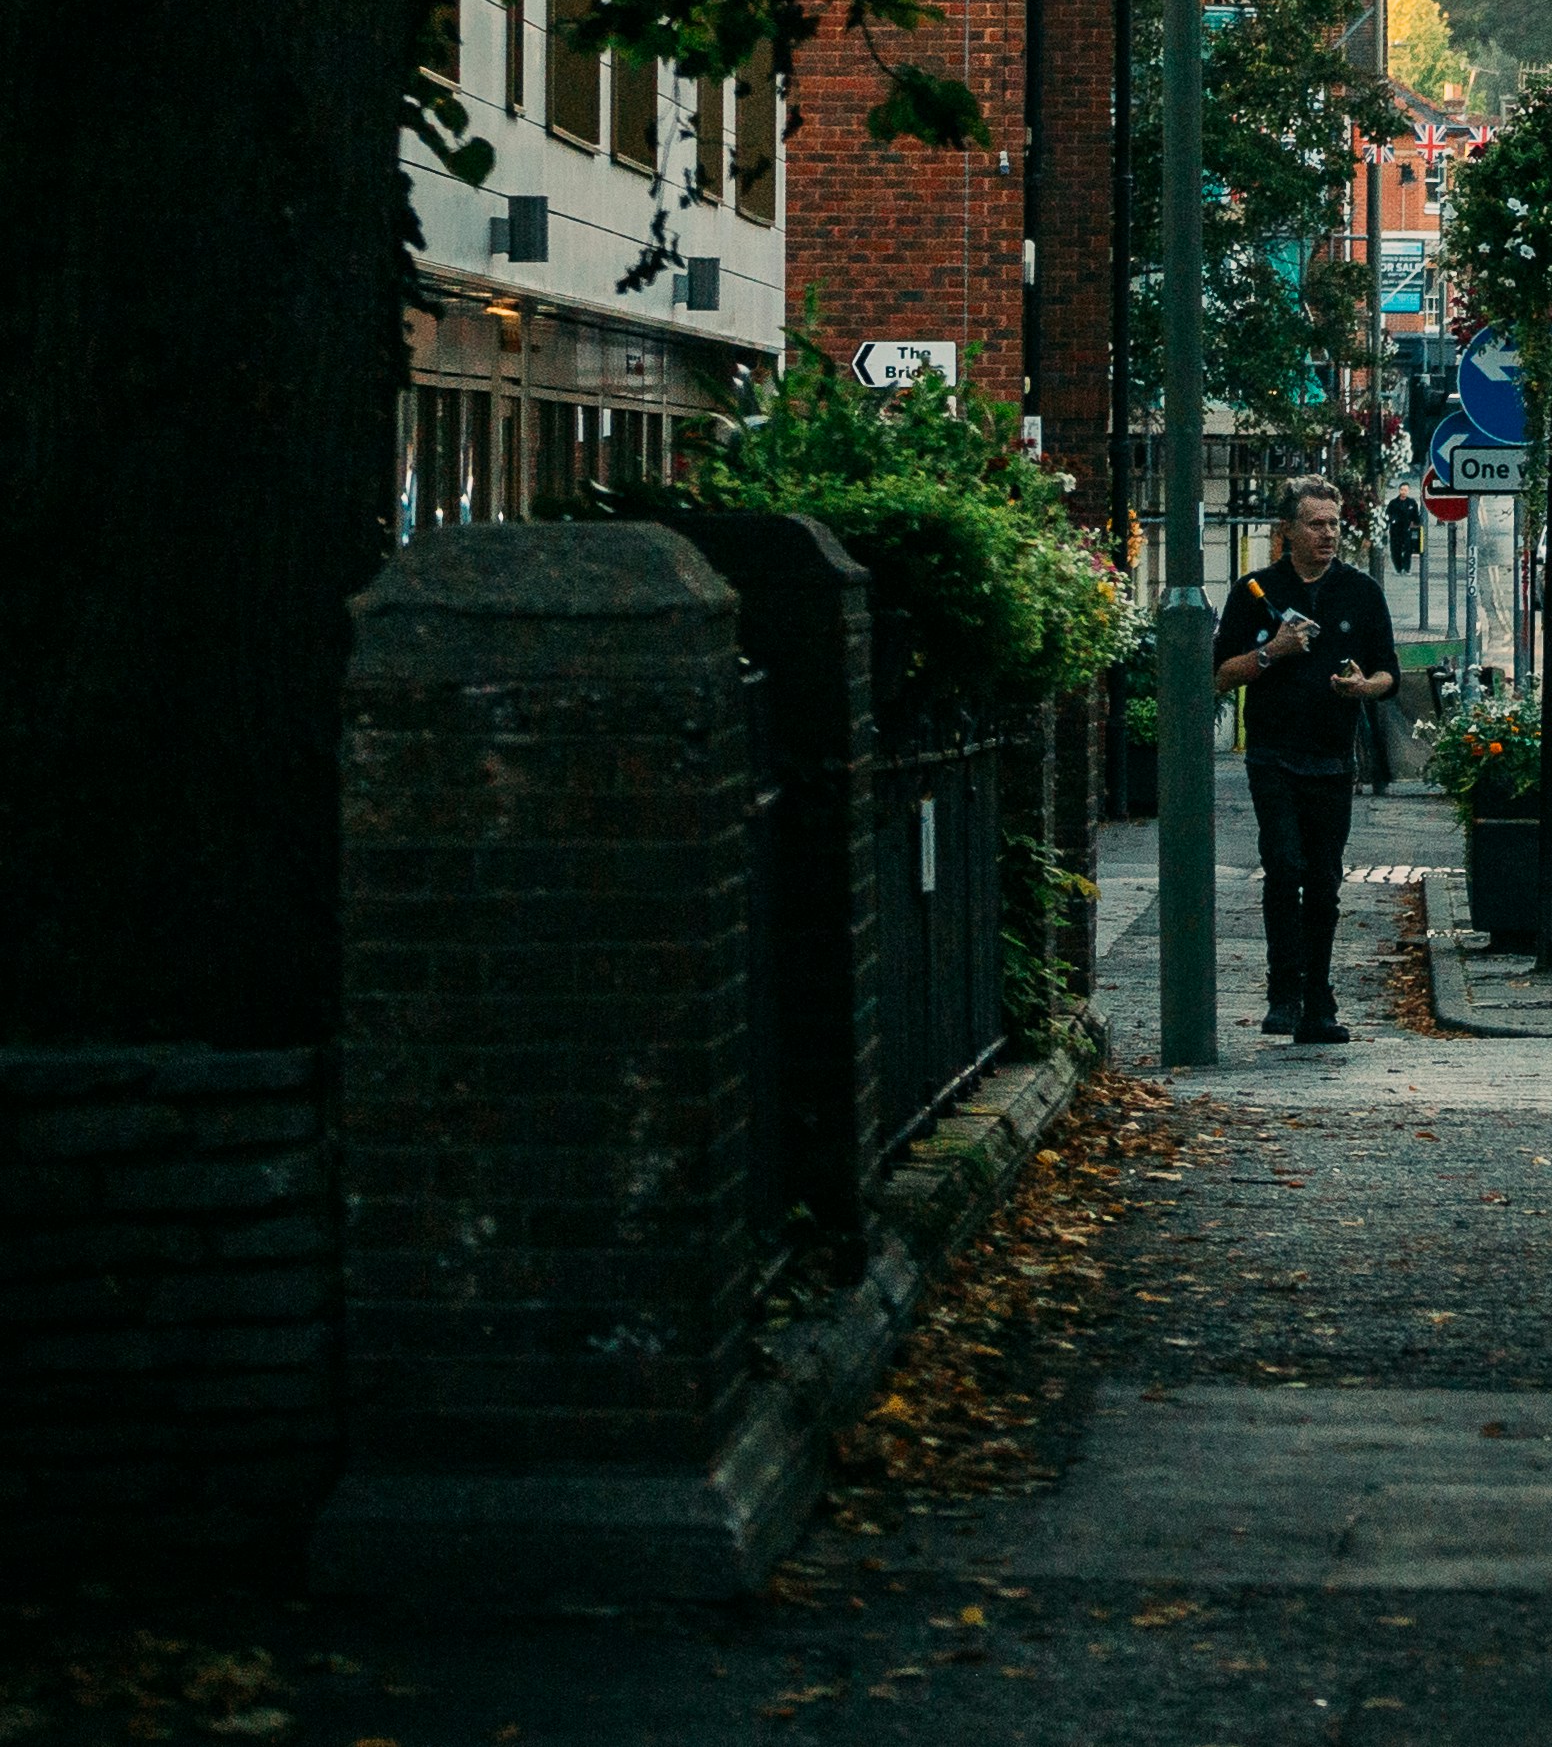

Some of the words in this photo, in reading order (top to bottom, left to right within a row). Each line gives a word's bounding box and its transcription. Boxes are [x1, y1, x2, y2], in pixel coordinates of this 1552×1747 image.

[1381, 262, 1394, 272] OR
[897, 347, 931, 359] The
[885, 365, 944, 379] Brid
[1461, 458, 1510, 479] One
